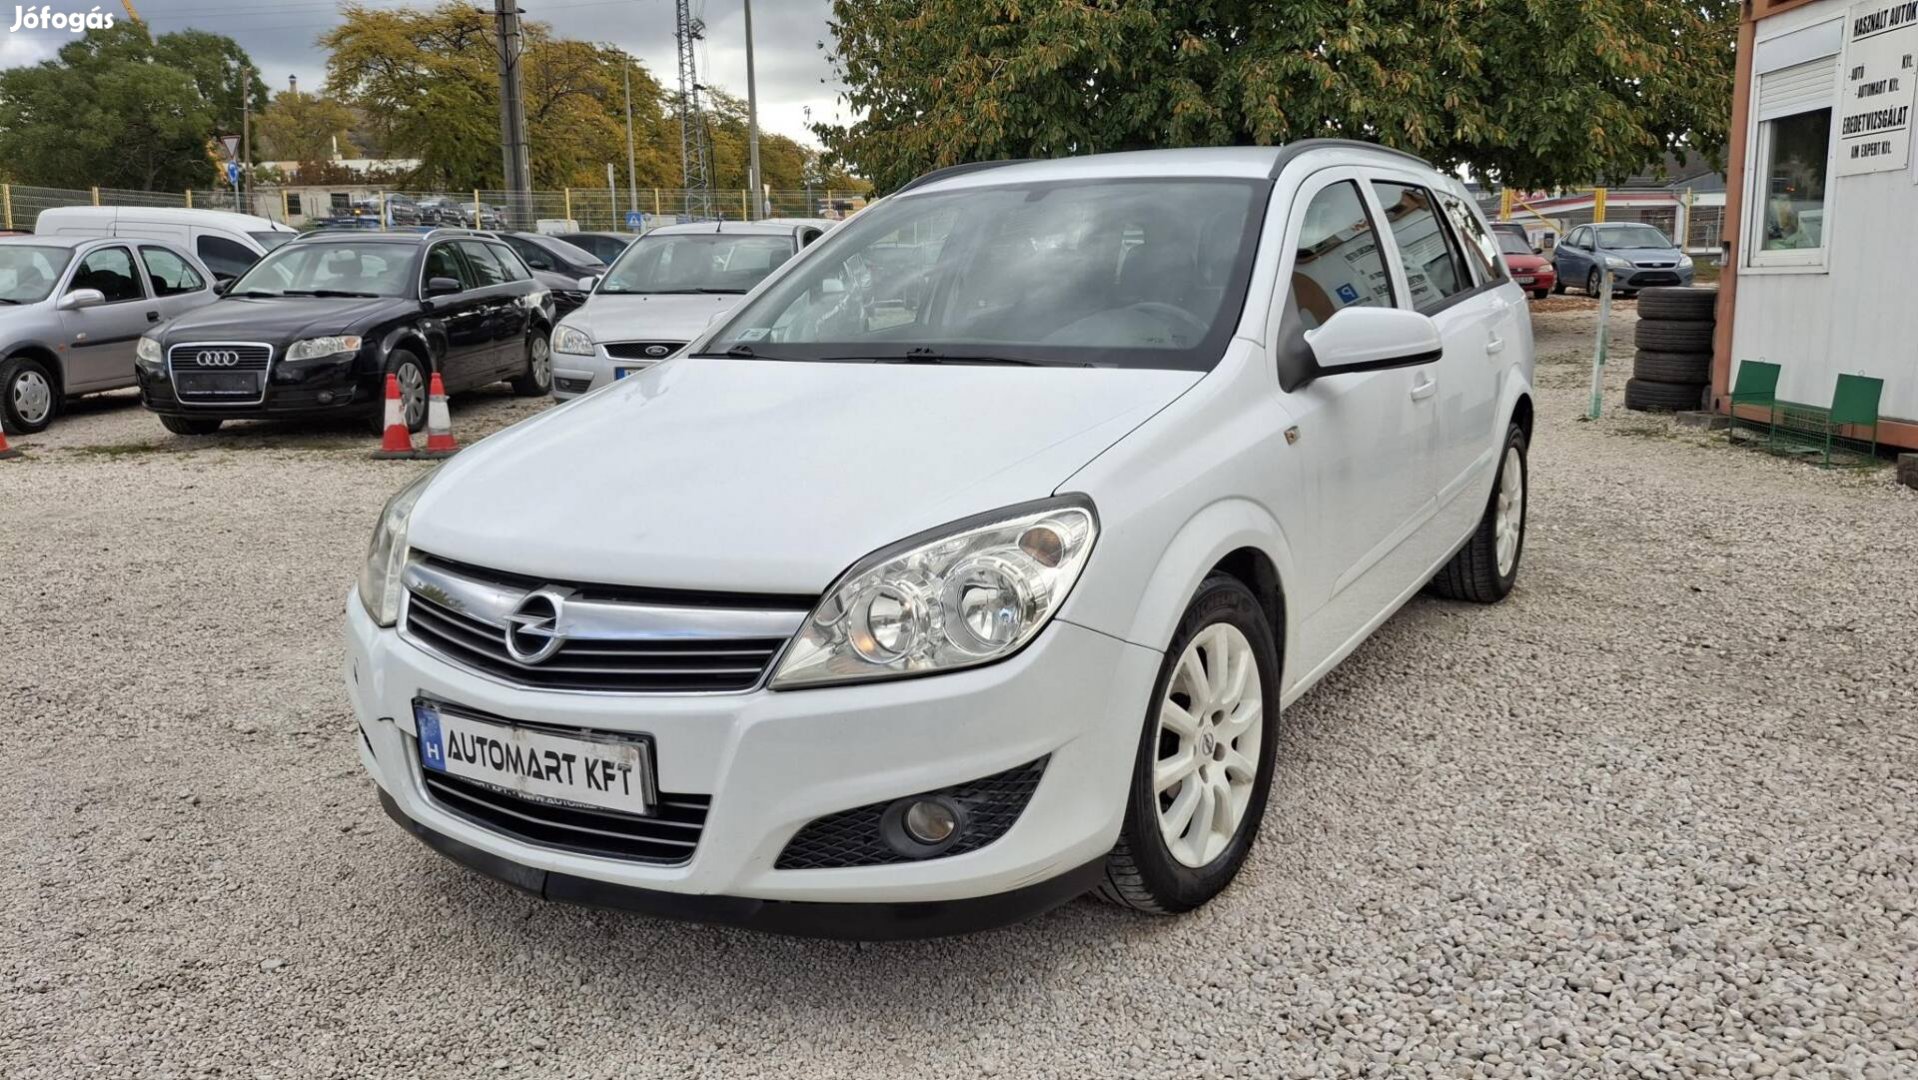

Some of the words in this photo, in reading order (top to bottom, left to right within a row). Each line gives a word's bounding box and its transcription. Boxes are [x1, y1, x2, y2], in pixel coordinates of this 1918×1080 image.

[1854, 8, 1888, 37] HASZNÁLT
[1842, 105, 1908, 135] EREDETVIZSGÁLAT
[426, 742, 440, 760] H
[448, 730, 577, 786] AUTOMART
[585, 757, 632, 796] KFT
